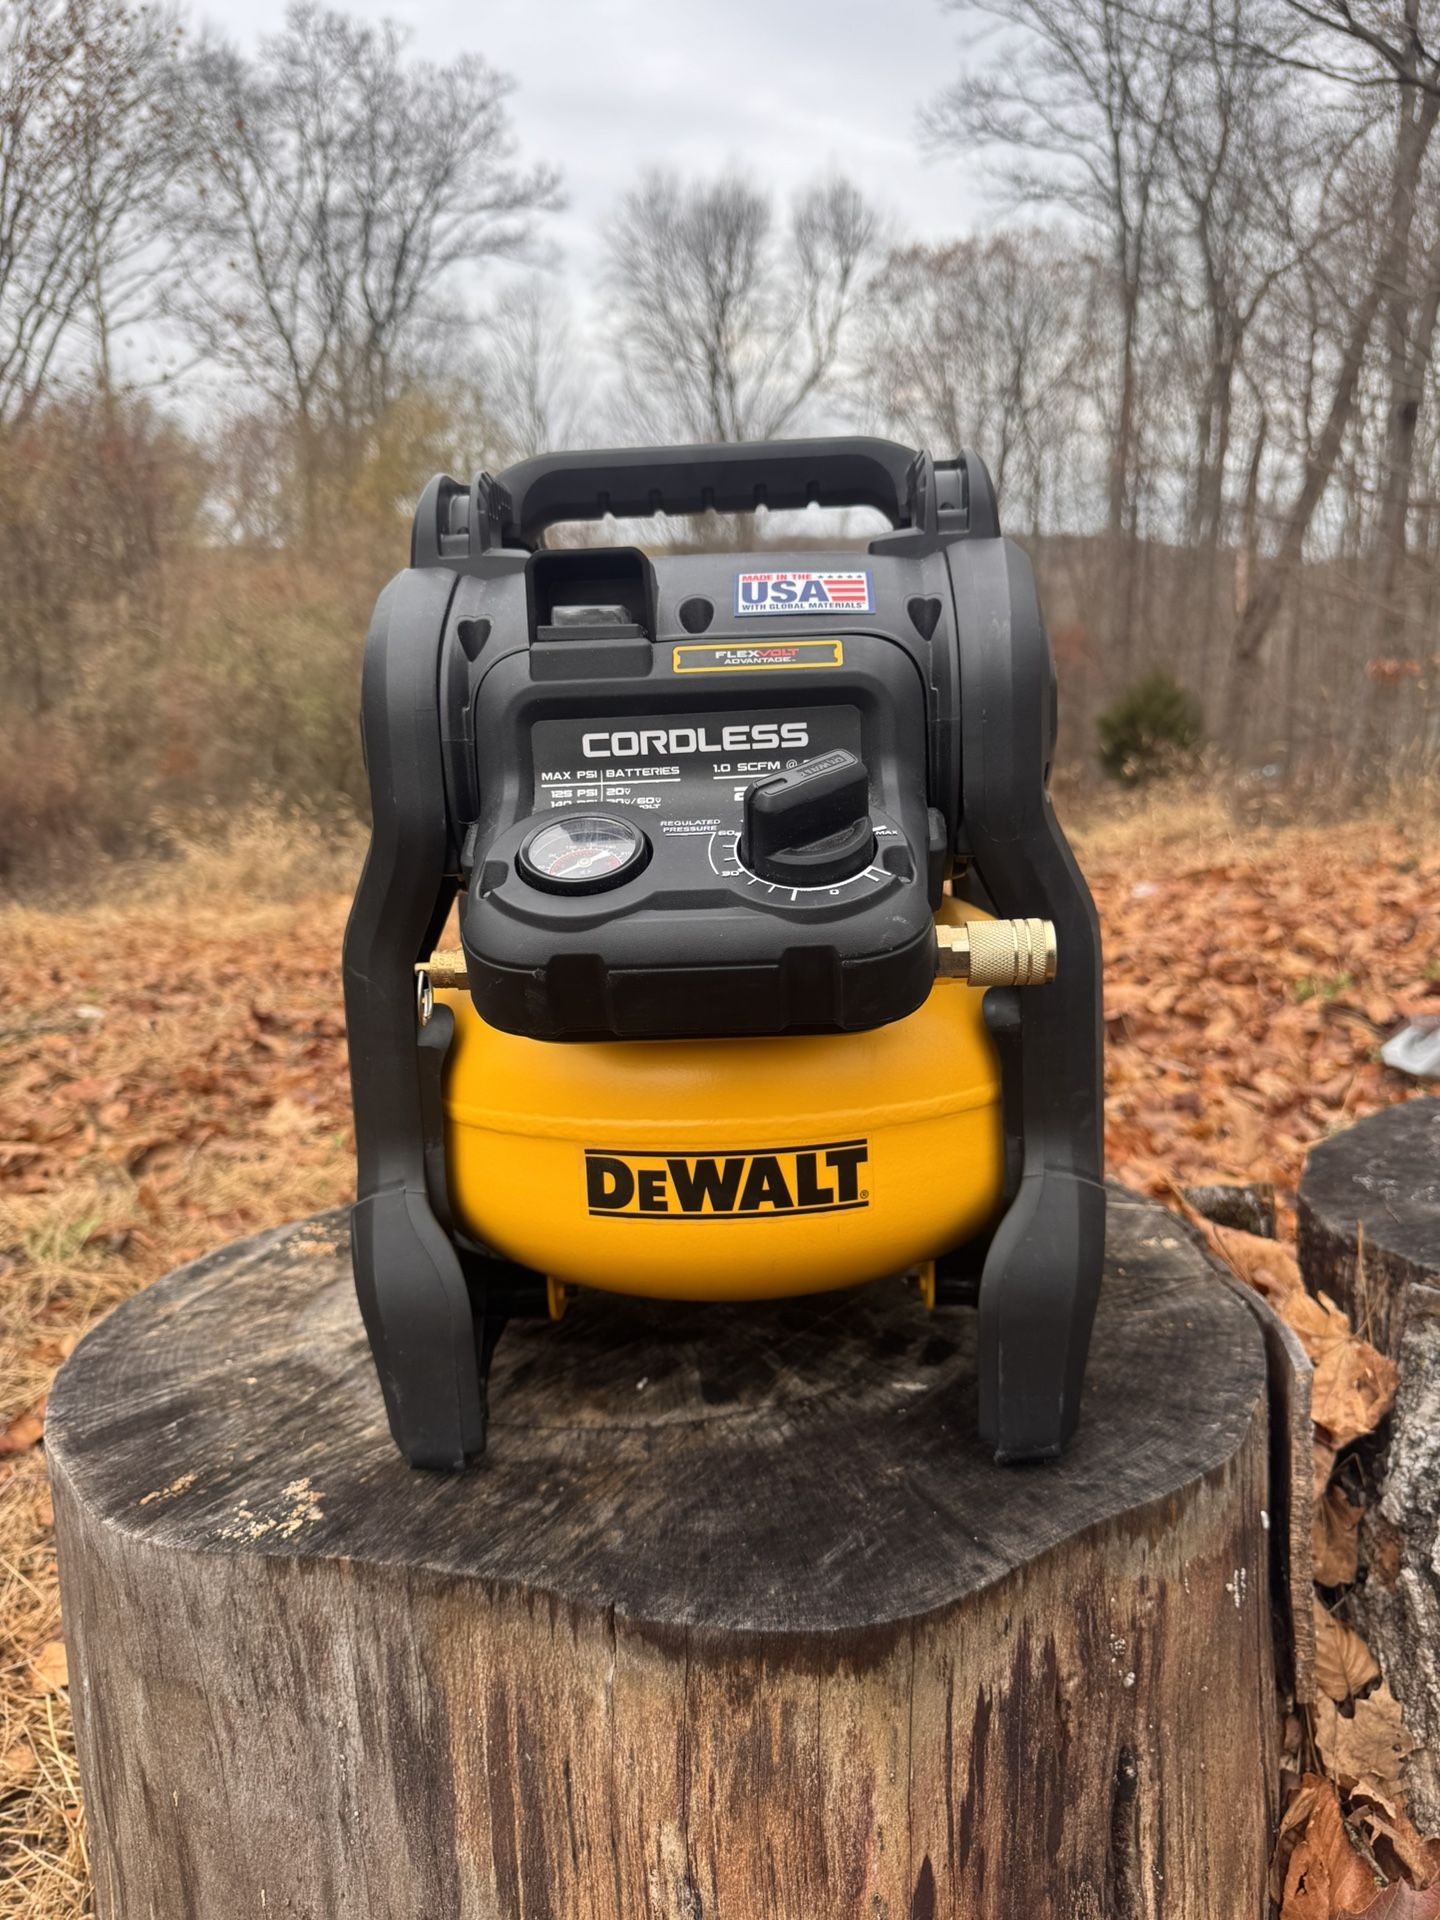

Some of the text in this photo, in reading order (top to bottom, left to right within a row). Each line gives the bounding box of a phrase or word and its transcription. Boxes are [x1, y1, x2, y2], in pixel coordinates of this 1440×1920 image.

[742, 574, 774, 582] MADE
[741, 580, 829, 604] USA
[742, 603, 766, 611] WITH
[769, 602, 805, 610] GLOBAL
[715, 648, 799, 659] FLEXVOLT
[582, 722, 809, 758] CORDLESS
[606, 766, 680, 778] BATTERIES
[713, 763, 731, 773] 1.0
[737, 761, 781, 771] SCFM
[541, 770, 598, 781] MAX PSI
[551, 788, 598, 798] 125 PSI
[663, 825, 718, 833] PRESSURE
